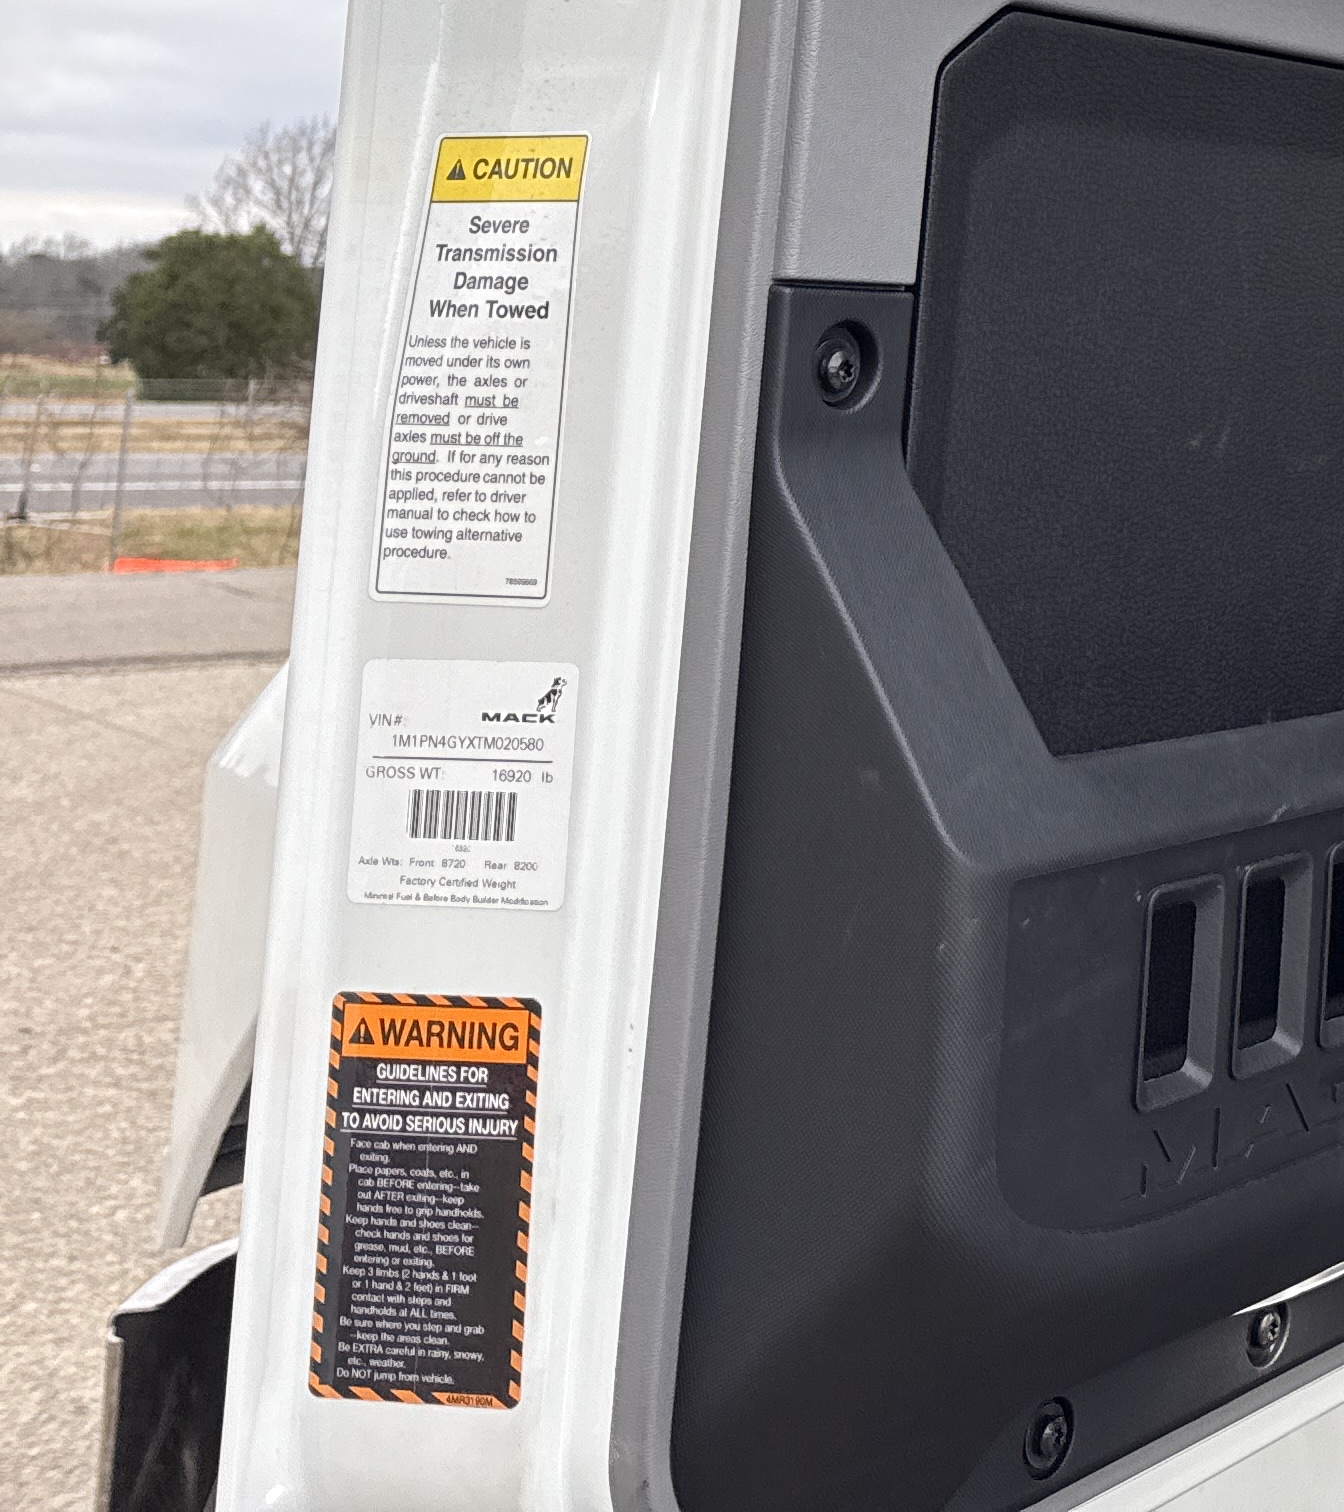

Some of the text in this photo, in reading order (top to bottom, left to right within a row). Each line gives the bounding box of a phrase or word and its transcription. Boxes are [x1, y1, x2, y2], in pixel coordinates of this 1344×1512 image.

[471, 156, 573, 179] CAUTION
[468, 215, 530, 233] Severe
[433, 243, 558, 262] Transmission
[452, 271, 530, 294] Damage
[427, 299, 550, 319] When Towed
[407, 334, 531, 349] Unless the vehicle is
[404, 354, 530, 368] moved under its own
[400, 374, 528, 388] power, the axles or
[398, 391, 519, 407] driveshaft must be
[395, 410, 508, 425] removed or drive
[393, 430, 523, 446] axles must be off the
[391, 449, 550, 467] ground. If for any reason
[389, 468, 545, 485] this procedure cannot be
[387, 486, 526, 503] applied, refer to driver
[386, 505, 536, 523] manual to check how to
[384, 526, 523, 543] use towing alternative
[481, 712, 556, 723] MACK
[391, 734, 544, 751] 1M1PN4GYXTM020580
[365, 765, 415, 779] GROSS
[492, 769, 531, 782] 16920
[541, 770, 553, 783] lb
[408, 858, 434, 867] Front
[483, 860, 507, 870] Rear
[399, 875, 516, 890] Factory Certified Weight
[377, 1017, 520, 1051] WARNING
[376, 1063, 488, 1083] GUIDELINES FOR
[353, 1087, 509, 1110] ENTERING AND EXITING
[340, 1112, 518, 1136] TO AVOID SERIOUS INJURY
[349, 1138, 477, 1154] Face cab when entering AND
[351, 1368, 372, 1379] NOT
[373, 1370, 396, 1382] jump
